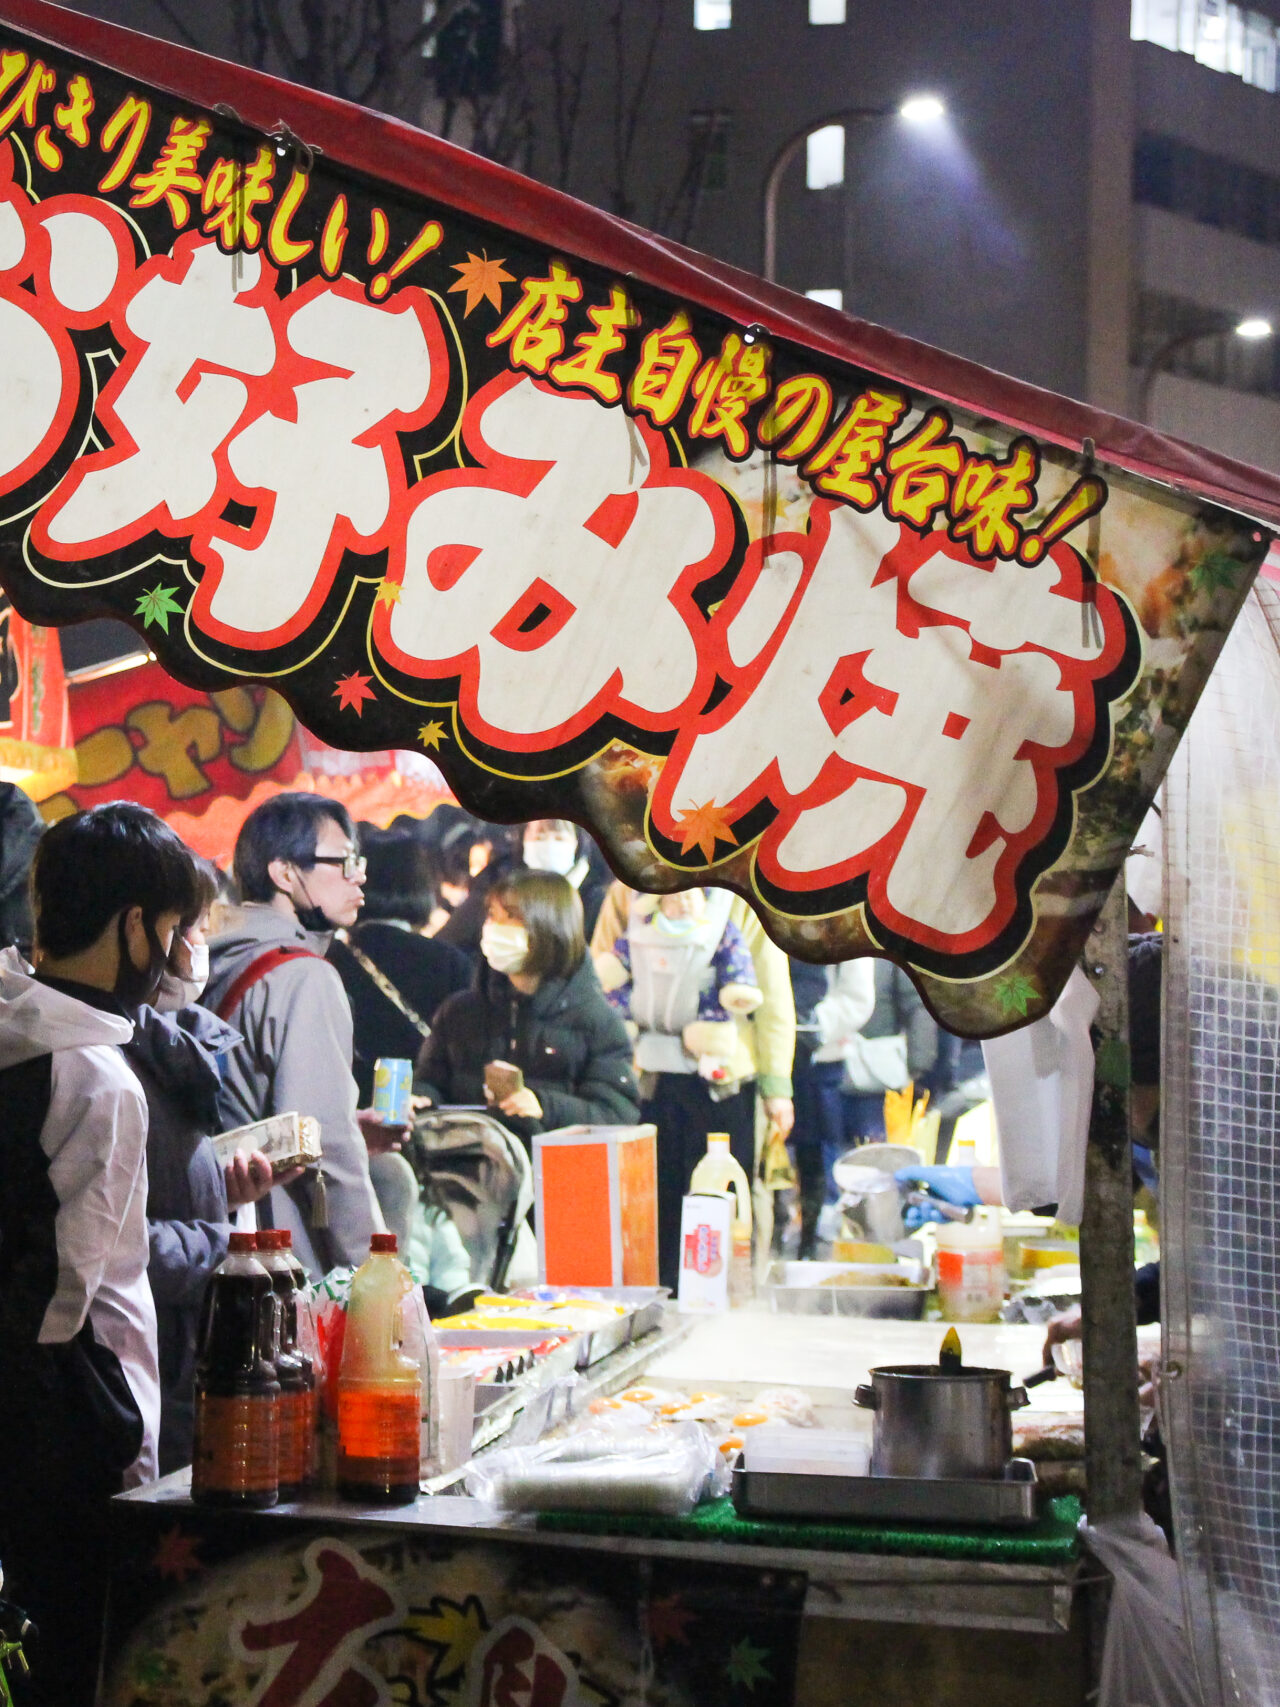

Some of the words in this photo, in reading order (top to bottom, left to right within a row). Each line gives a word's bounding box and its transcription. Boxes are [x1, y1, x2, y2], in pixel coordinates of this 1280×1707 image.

[487, 258, 1108, 565] 店主自慢の屋台味!
